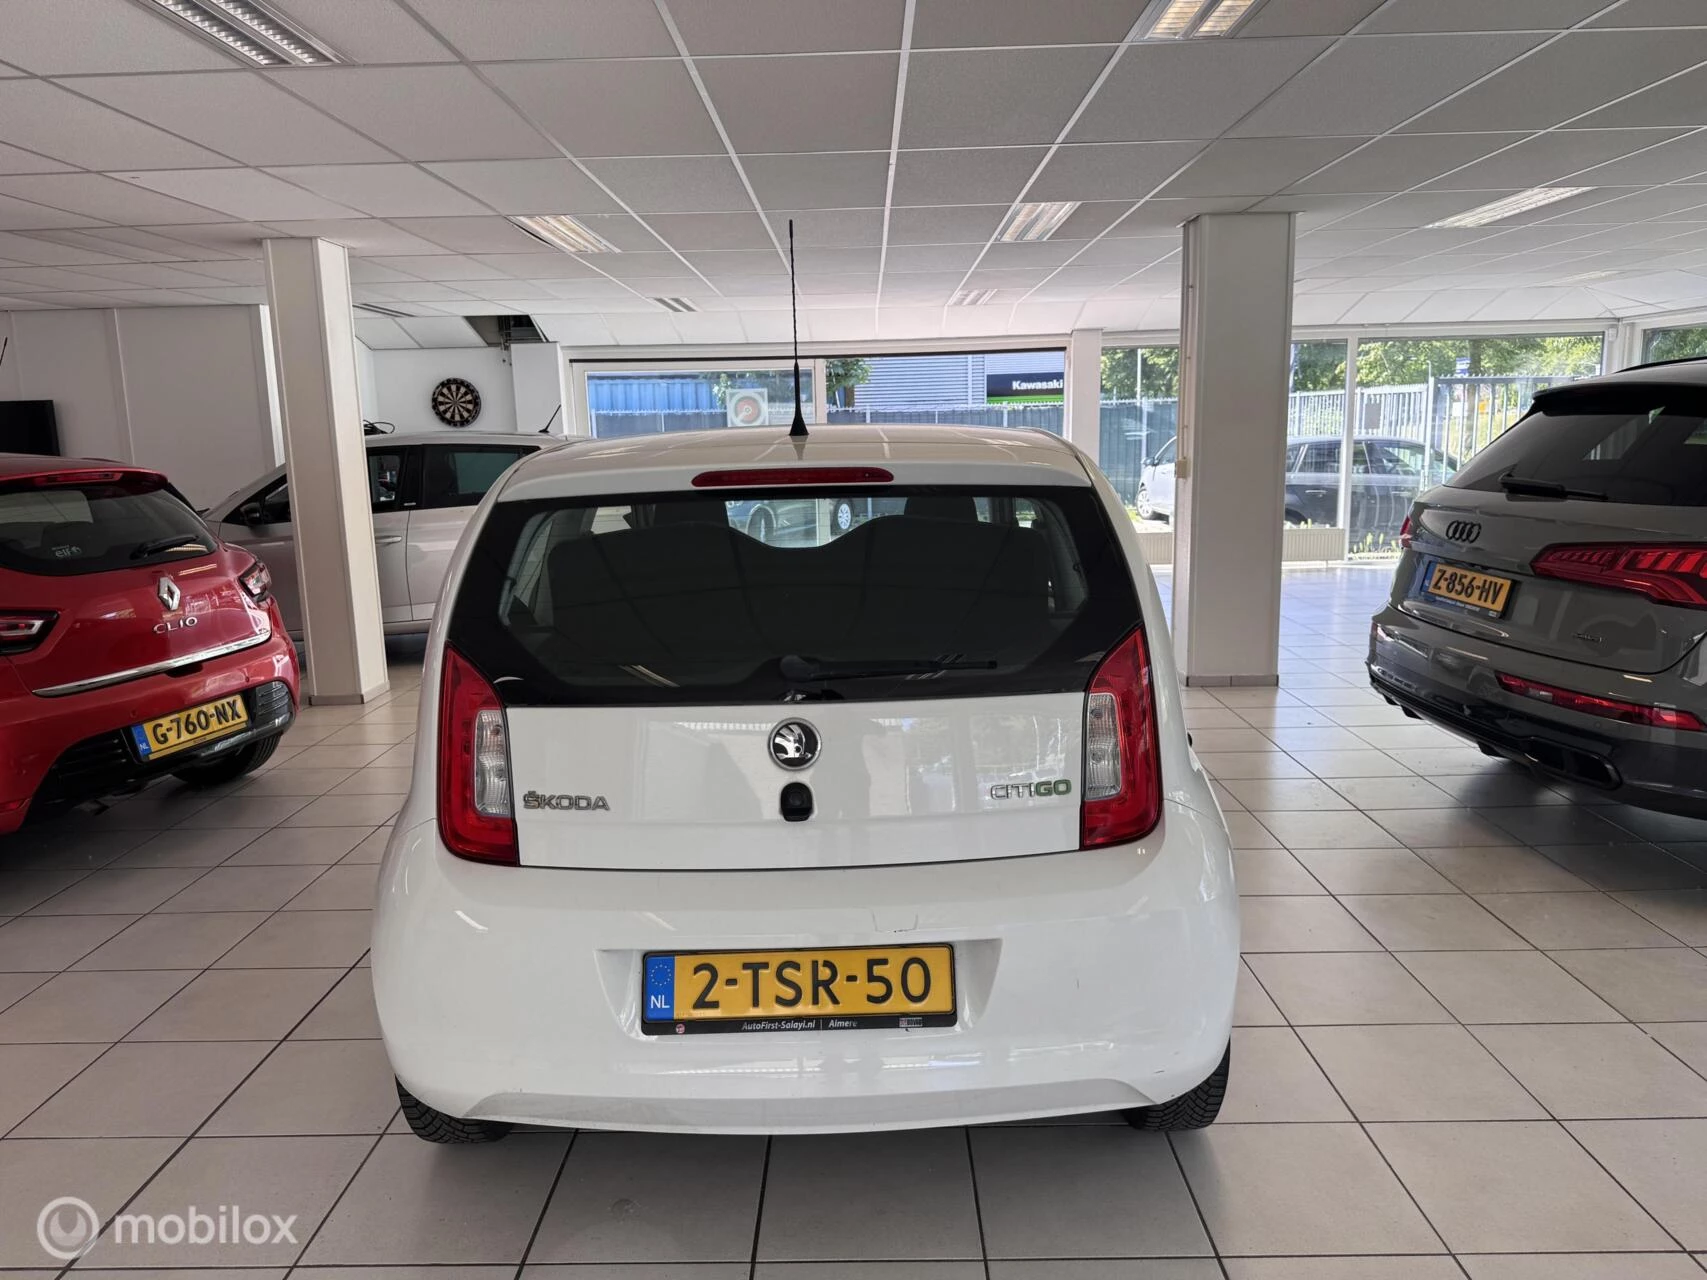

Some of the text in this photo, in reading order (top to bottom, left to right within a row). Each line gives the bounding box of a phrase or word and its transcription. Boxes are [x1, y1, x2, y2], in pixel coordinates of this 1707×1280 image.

[1012, 379, 1063, 390] Kawasaki
[1433, 569, 1504, 605] Z-856-HV
[153, 616, 198, 634] CLIO
[152, 699, 241, 745] G-760-NX
[990, 779, 1072, 800] CITIGO
[523, 790, 610, 811] ŠKODA
[691, 957, 931, 1010] 2-TSR-50
[650, 994, 670, 1009] NL
